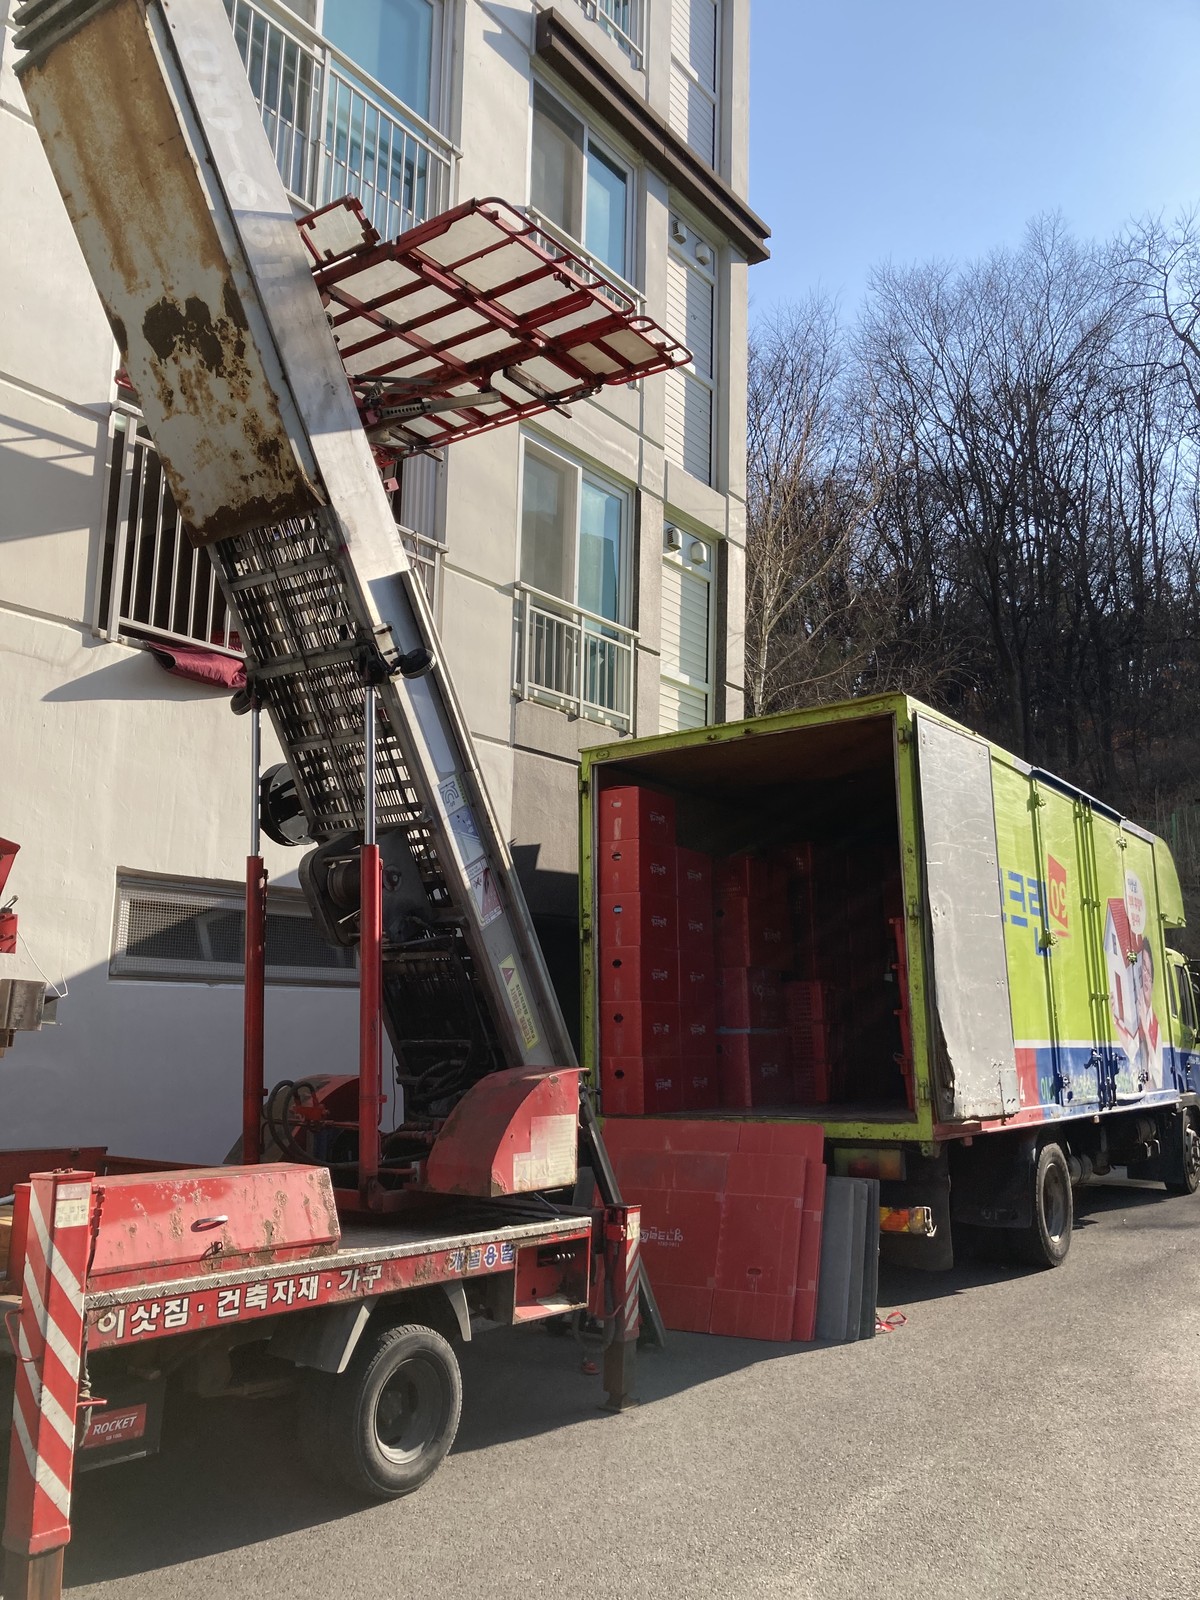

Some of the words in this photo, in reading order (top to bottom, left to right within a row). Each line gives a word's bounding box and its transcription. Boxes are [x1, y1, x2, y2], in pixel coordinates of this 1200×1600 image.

[97, 1297, 190, 1339] 이삿짐
[216, 1274, 319, 1319] 건축자재
[338, 1264, 384, 1292] 가구
[92, 1414, 138, 1437] ROCKET
